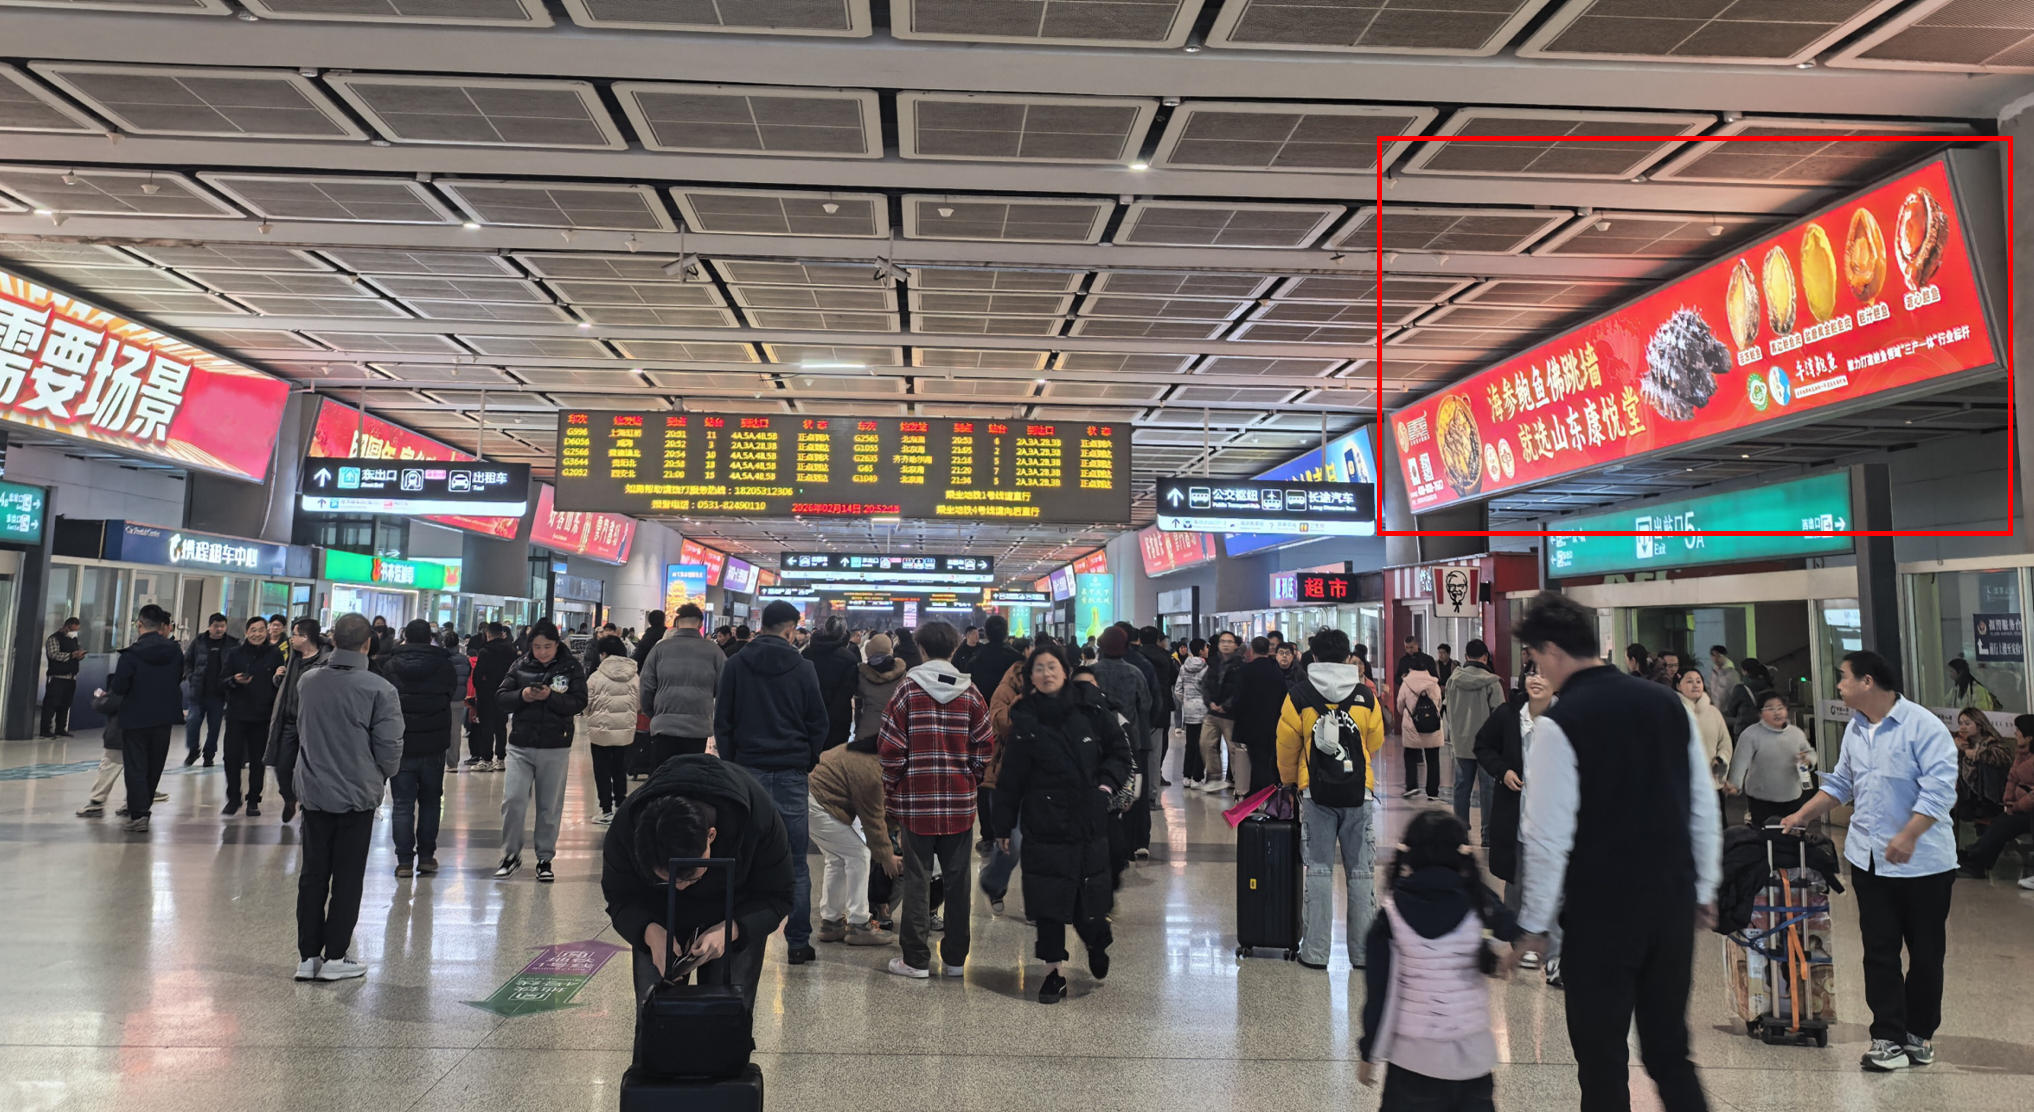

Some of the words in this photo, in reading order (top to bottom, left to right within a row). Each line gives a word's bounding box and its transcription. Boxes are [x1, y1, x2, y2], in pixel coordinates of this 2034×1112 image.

[1487, 341, 1602, 423] 海参鲍鱼佛跳墙
[568, 414, 588, 424] 车次
[613, 416, 643, 426] 始发站
[704, 417, 724, 428] 站台
[741, 418, 769, 428] 到达口
[858, 422, 877, 431] 车次
[900, 422, 928, 432] 始发站
[988, 424, 1008, 434] 站台
[1027, 425, 1055, 436] 到达口
[1518, 386, 1646, 463] 就选山东康悦堂
[566, 428, 588, 436] G996
[798, 433, 830, 442] 正点到达
[902, 436, 925, 444] 北京南
[1081, 440, 1112, 448] 正点到达
[798, 443, 830, 452] 正点到达
[902, 445, 925, 454] 北京南
[1080, 449, 1112, 458] 正点到达
[797, 453, 829, 462] 正点到达
[1080, 460, 1112, 469] 正点到达
[797, 462, 829, 472] 正点到达
[901, 465, 925, 474] 北京南
[1080, 468, 1112, 479] 正点到达
[361, 469, 397, 481] 东出口
[472, 472, 507, 484] 出租车
[611, 469, 636, 478] 西安北
[797, 473, 828, 483] 正点到达
[901, 476, 924, 484] 北京南
[1080, 480, 1112, 489] 正点到达
[1212, 489, 1258, 501] 公交枢纽
[1308, 491, 1354, 504] 长途汽车
[792, 503, 860, 514] 2026年02月14日
[1684, 511, 1705, 549] 5A
[181, 540, 258, 567] 携程租车中心
[1304, 577, 1349, 599] 超市
